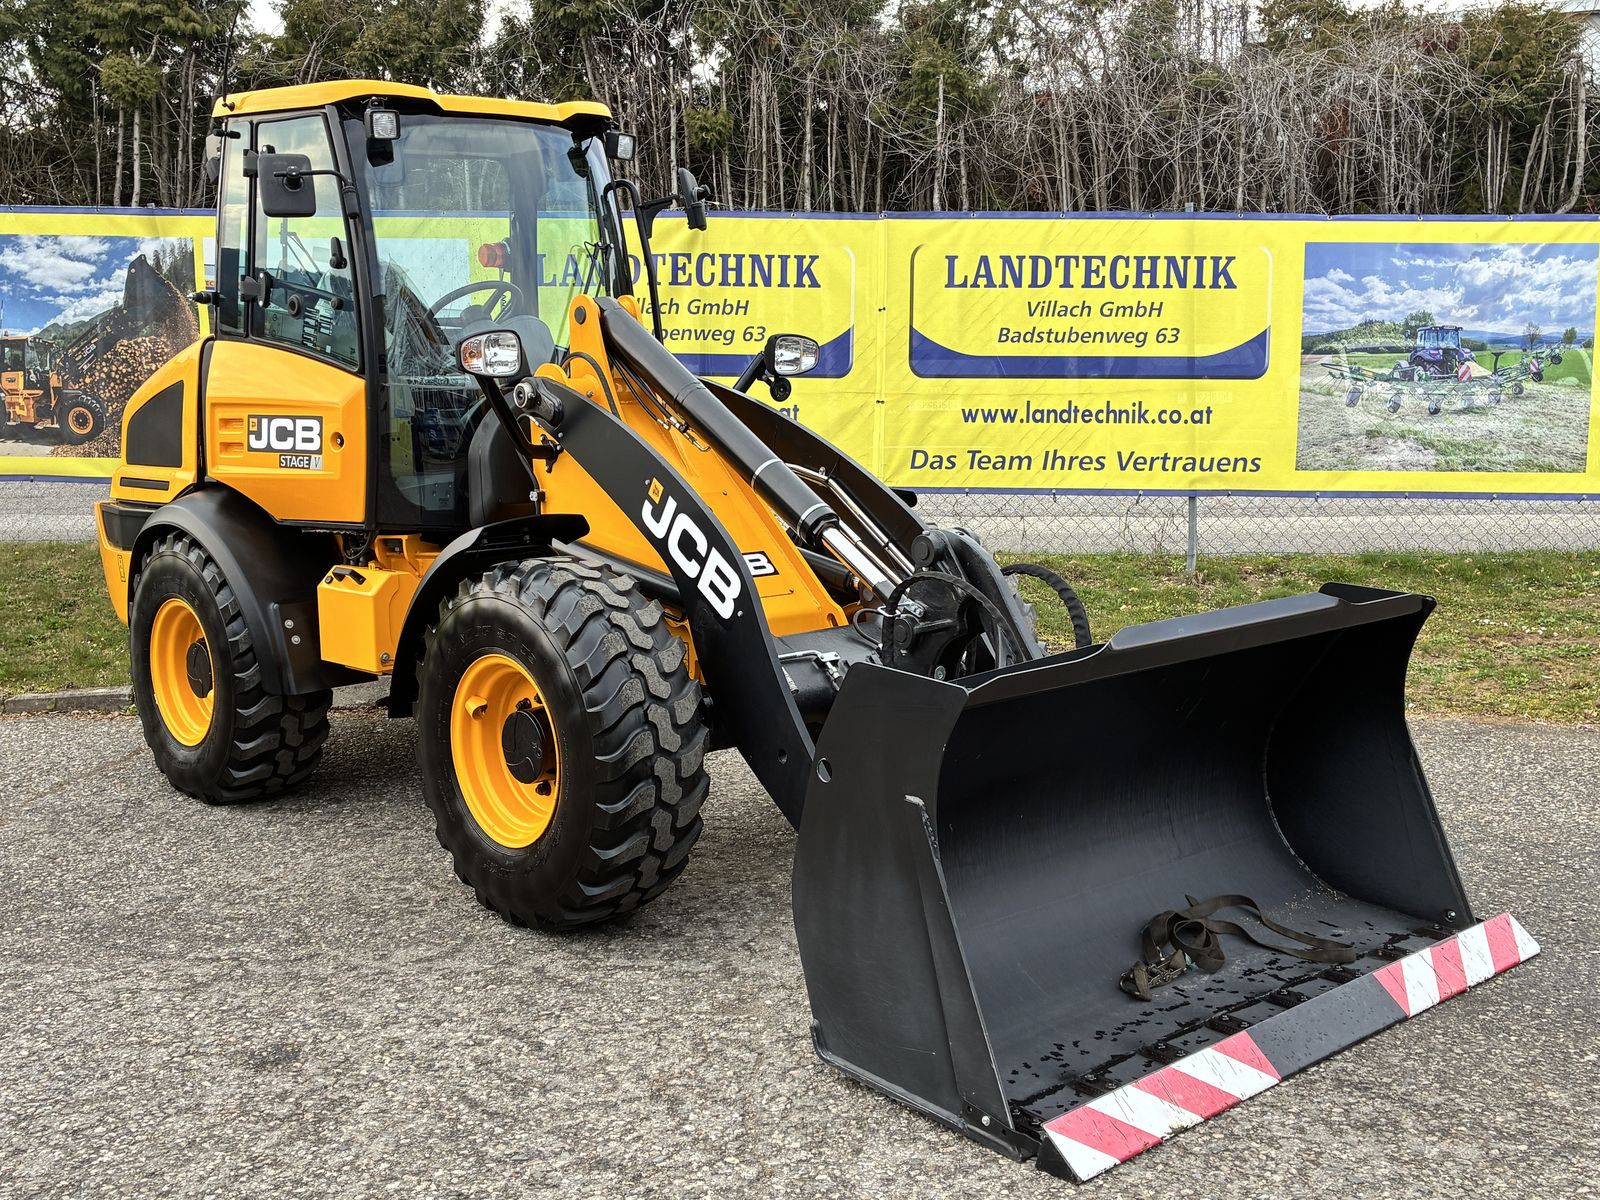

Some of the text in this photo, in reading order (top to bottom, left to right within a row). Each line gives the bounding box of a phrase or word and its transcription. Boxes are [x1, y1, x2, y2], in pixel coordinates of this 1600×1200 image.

[944, 255, 1237, 289] LANDTECHNIK
[687, 299, 749, 316] GmbH
[1026, 300, 1163, 318] Villach GmbH
[743, 325, 766, 342] 63
[997, 327, 1180, 347] Badstubenweg 63
[961, 400, 1213, 425] www.landtechnik.co.at
[248, 417, 321, 451] JCB
[280, 455, 309, 468] STAGE
[910, 449, 1262, 473] Das Team Ihres Vertrauens
[641, 495, 742, 620] JCB
